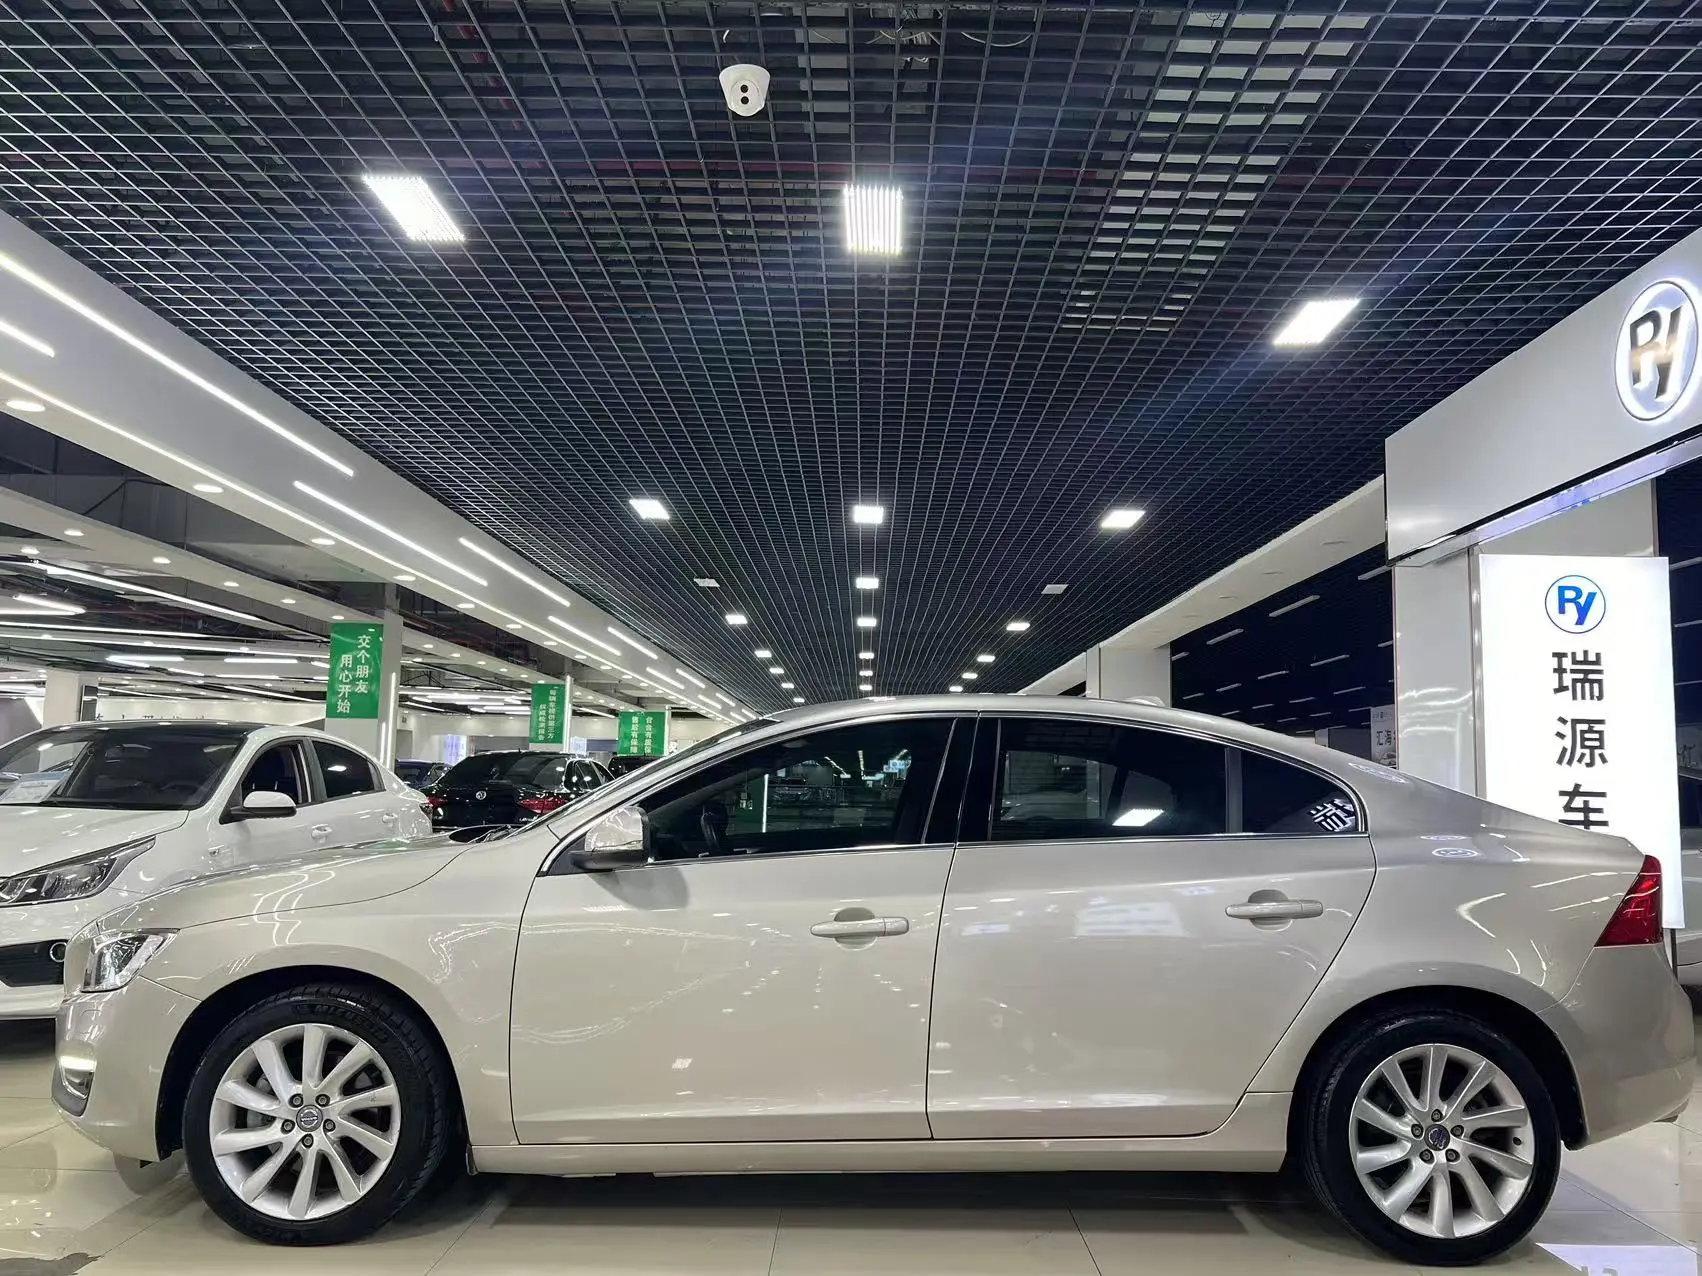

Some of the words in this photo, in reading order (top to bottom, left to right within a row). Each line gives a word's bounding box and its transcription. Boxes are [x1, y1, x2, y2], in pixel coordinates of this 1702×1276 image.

[336, 654, 353, 714] 用心开始
[355, 634, 371, 694] 交个朋友
[1551, 649, 1609, 830] 瑞源车
